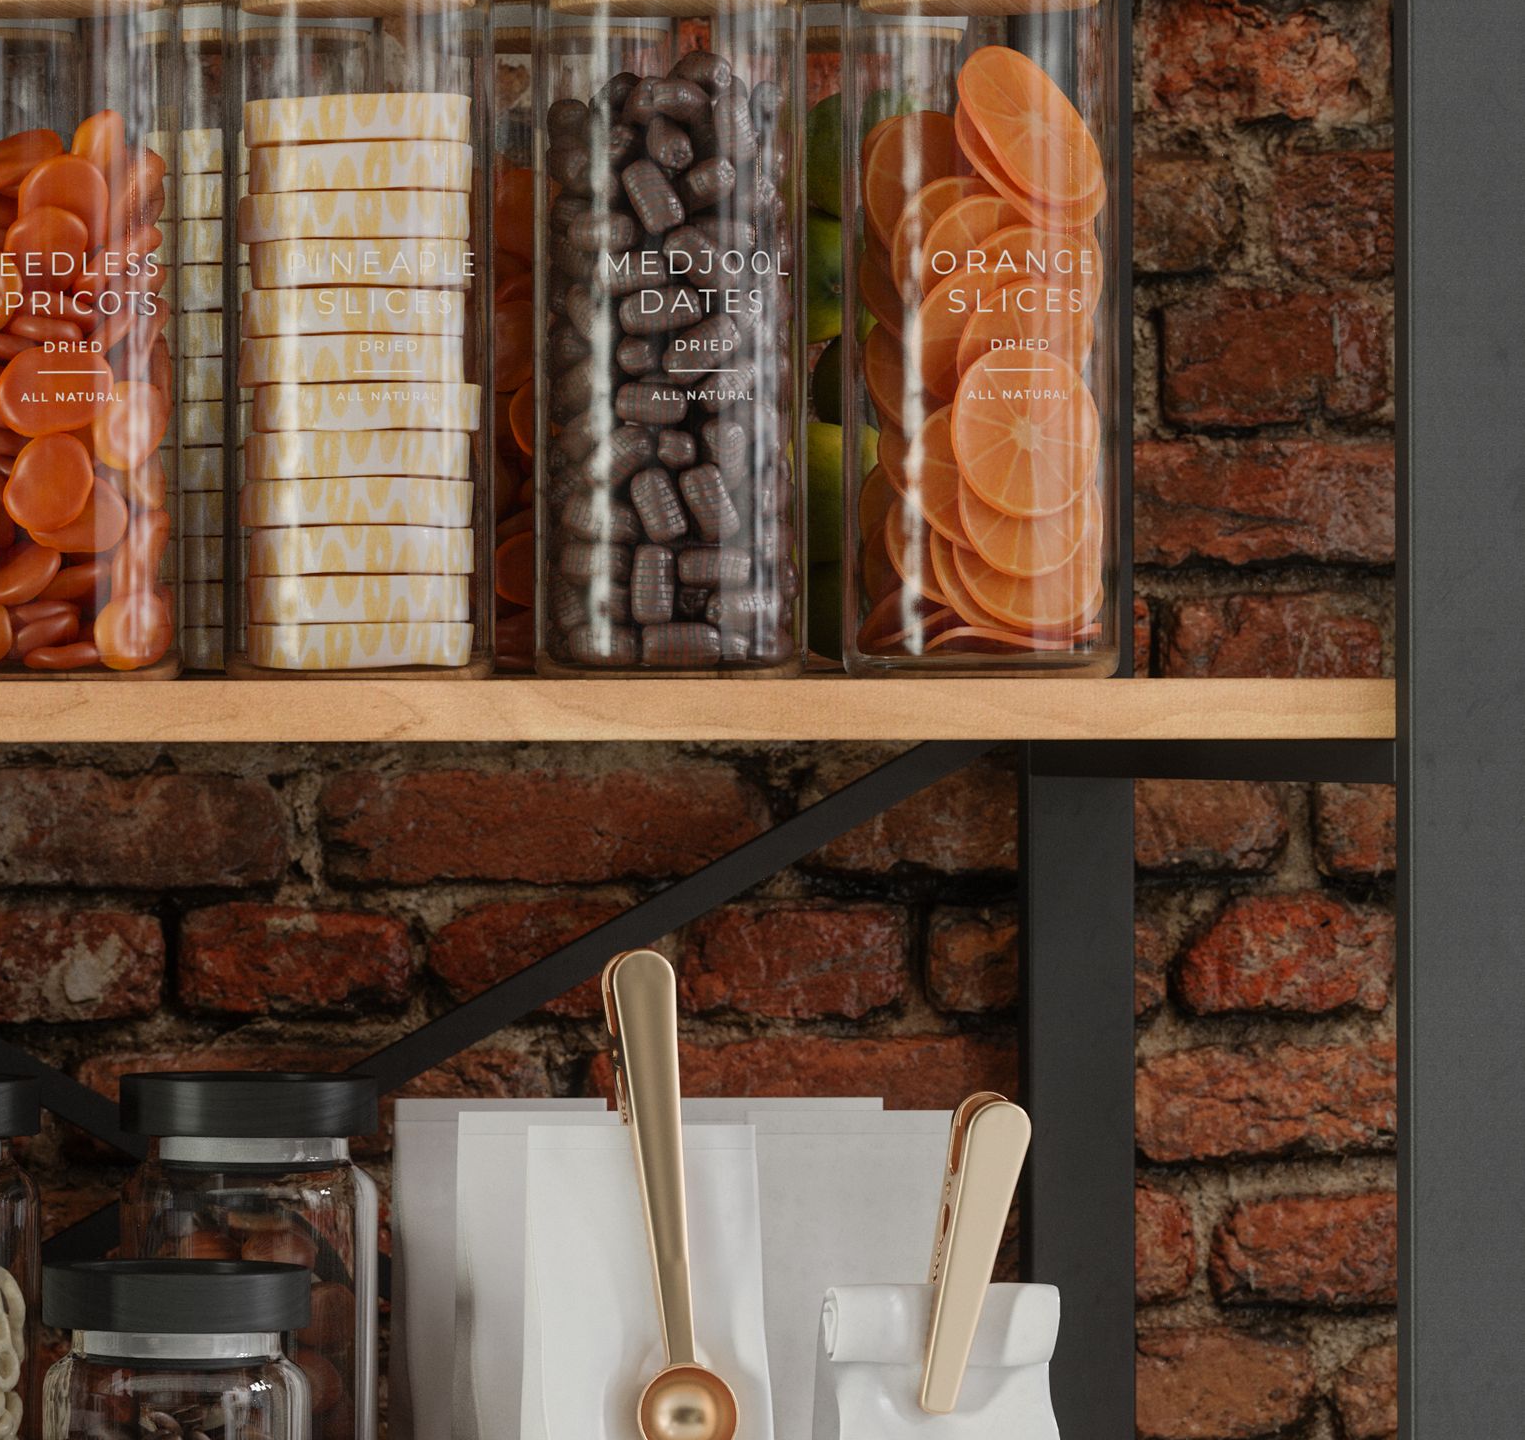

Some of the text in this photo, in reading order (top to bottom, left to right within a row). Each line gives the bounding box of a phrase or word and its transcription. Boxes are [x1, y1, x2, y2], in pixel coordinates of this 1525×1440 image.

[604, 250, 789, 276] MEDJOOL
[931, 249, 1094, 275] ORANGE
[318, 289, 453, 315] SLICES
[640, 288, 763, 314] DATES
[947, 288, 1083, 313] SLICES
[43, 340, 103, 354] DRIED
[359, 340, 419, 353] DRIED
[675, 339, 734, 352] DRIED
[990, 338, 1050, 352] DRIED
[21, 392, 123, 404] ALL NATURAL
[652, 390, 754, 401] ALL NATURAL
